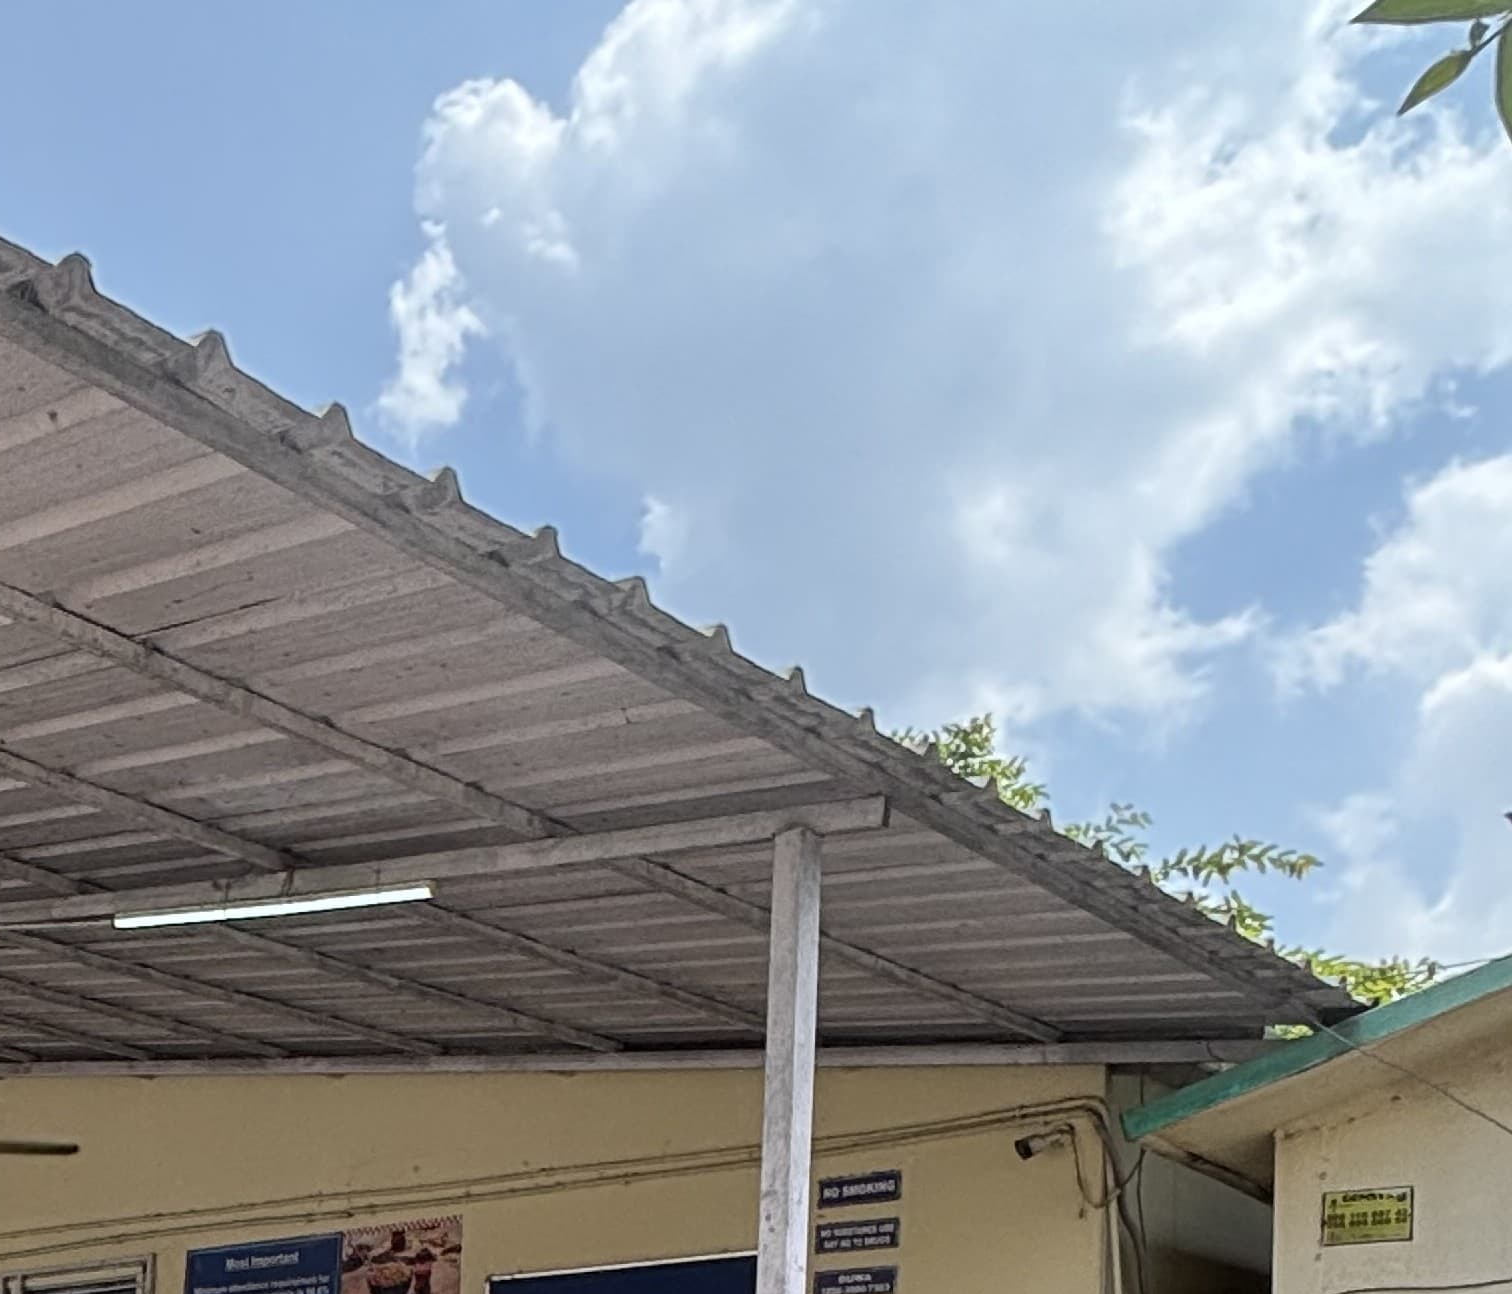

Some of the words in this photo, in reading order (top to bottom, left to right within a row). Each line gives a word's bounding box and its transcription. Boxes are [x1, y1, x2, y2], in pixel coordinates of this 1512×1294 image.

[823, 1187, 840, 1199] NO
[842, 1180, 895, 1197] SMOKING
[225, 1257, 250, 1271] Most
[251, 1252, 299, 1269] Important
